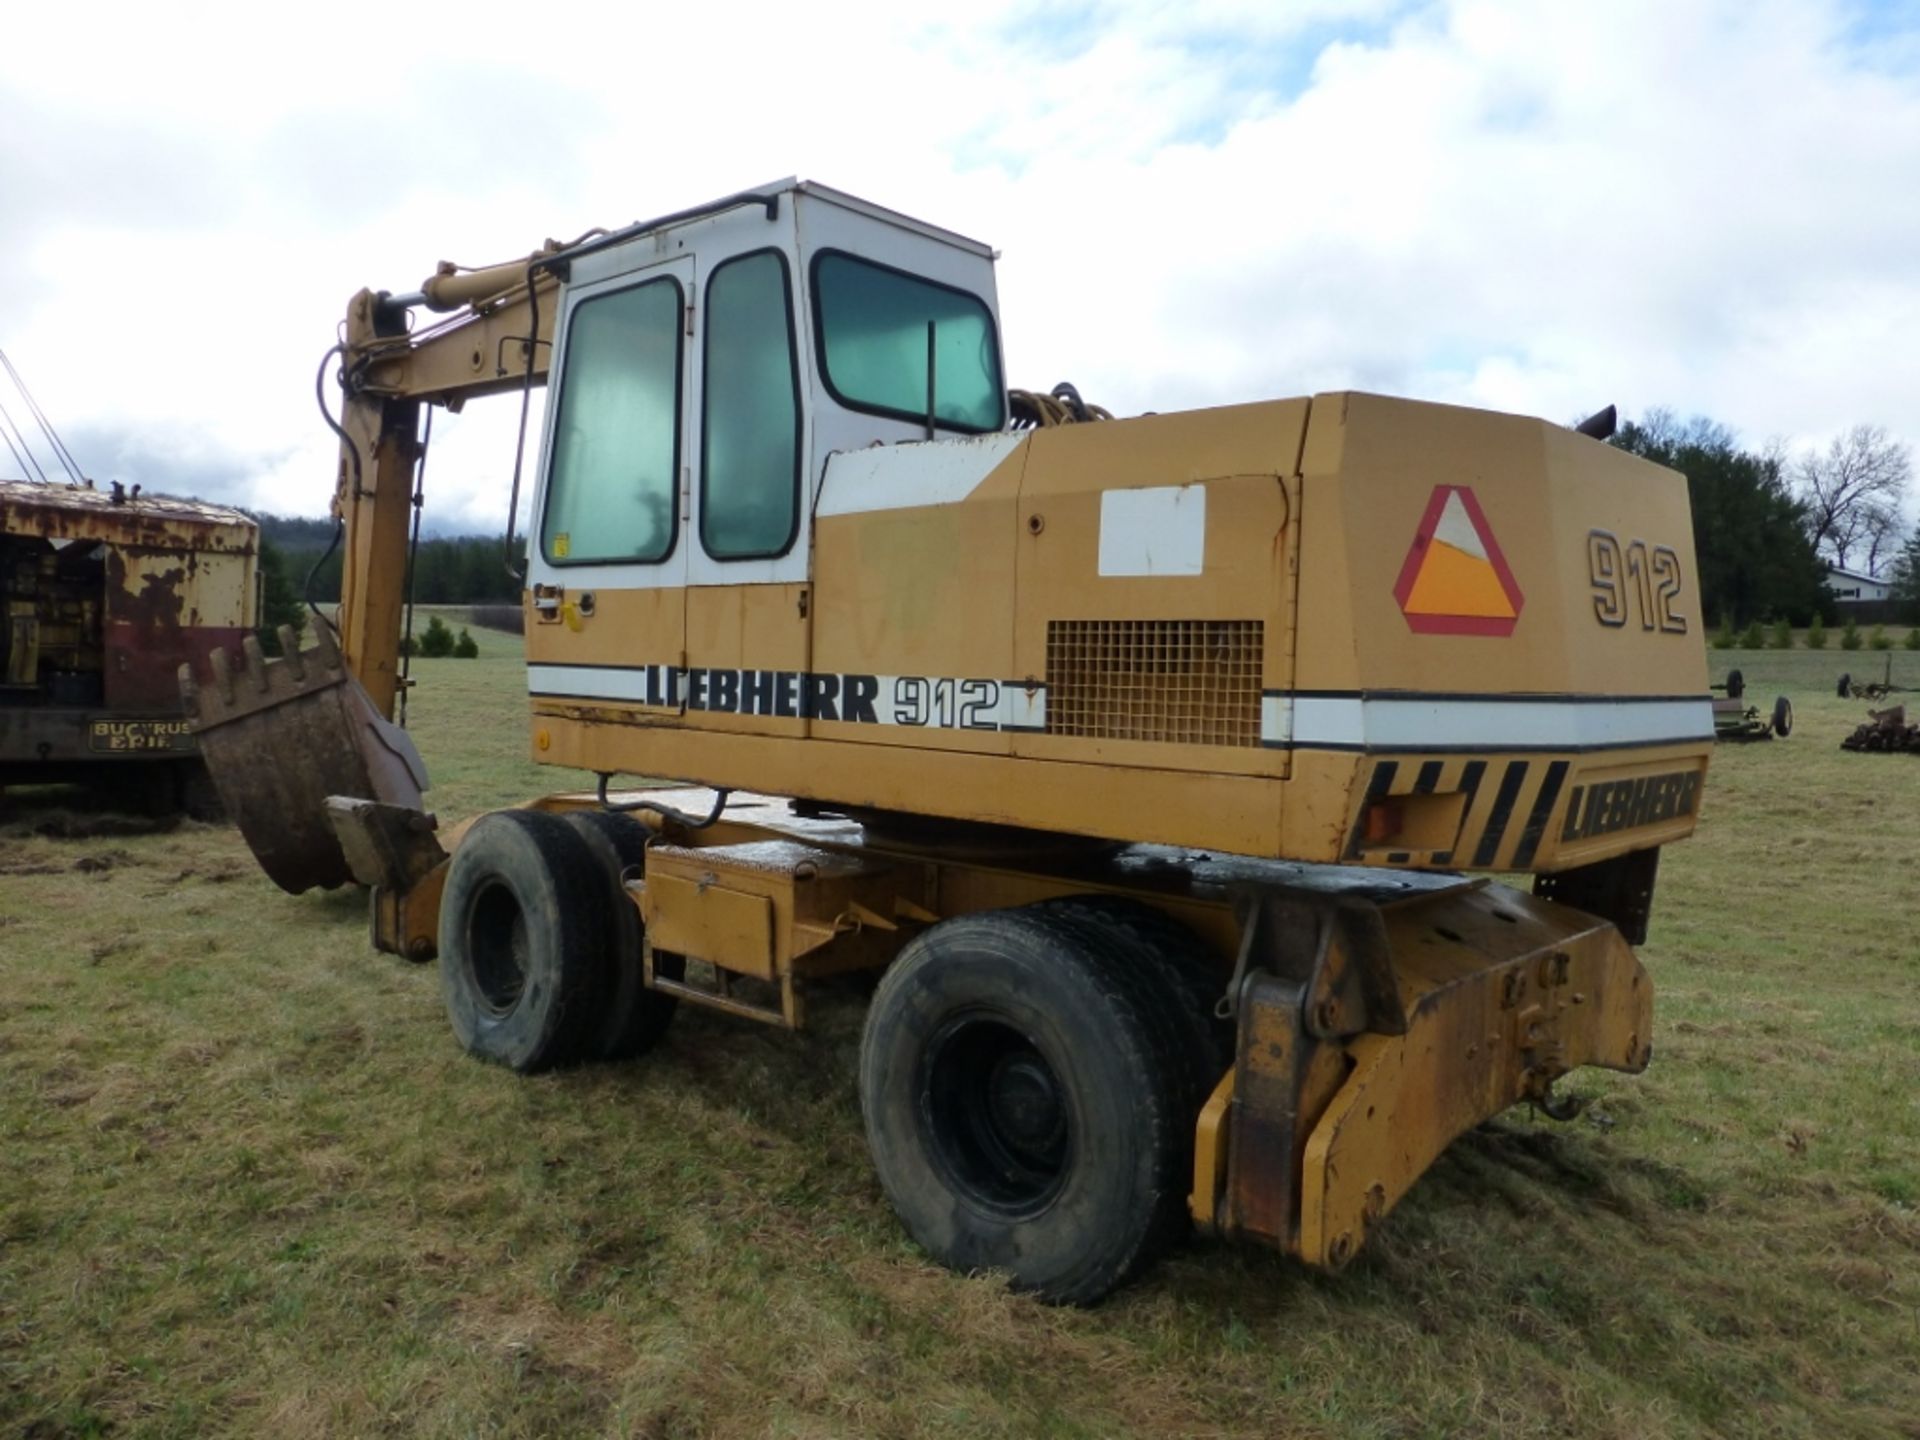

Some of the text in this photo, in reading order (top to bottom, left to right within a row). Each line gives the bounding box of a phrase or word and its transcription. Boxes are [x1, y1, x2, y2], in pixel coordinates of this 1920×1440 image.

[1587, 528, 1687, 635] 912
[646, 665, 999, 731] LIEBHERR 912
[1561, 770, 1701, 844] LIEBHERR
